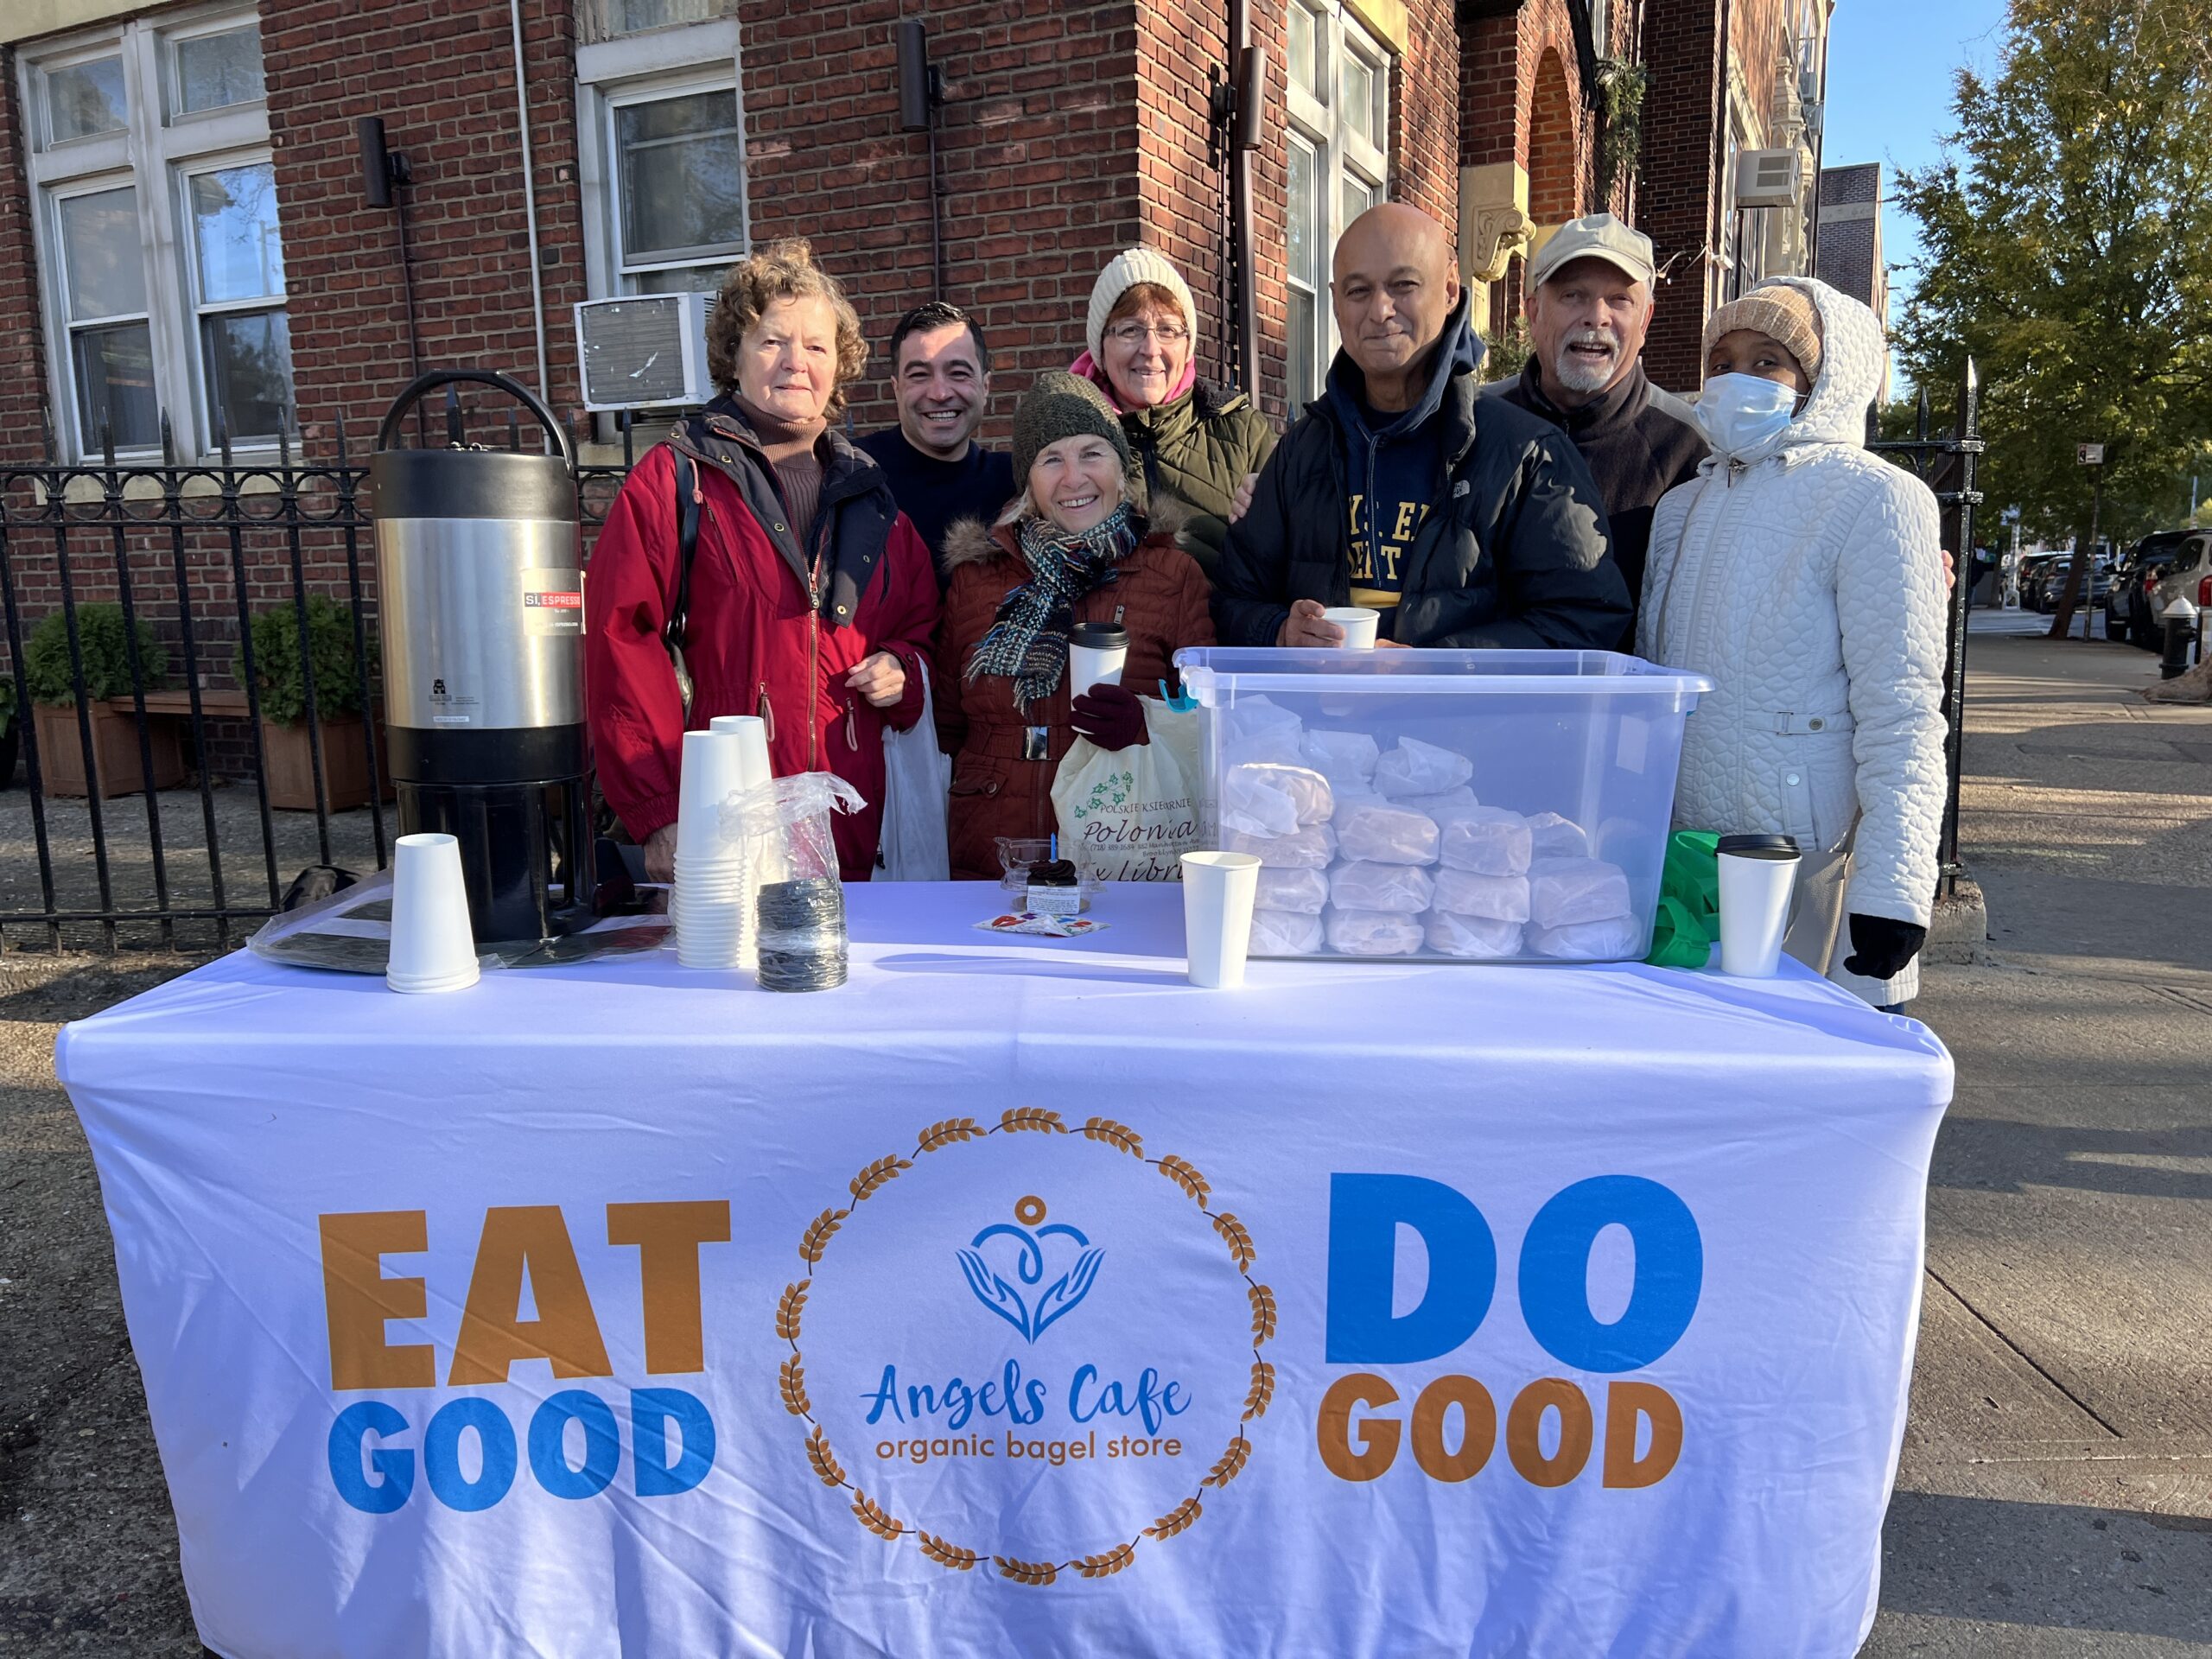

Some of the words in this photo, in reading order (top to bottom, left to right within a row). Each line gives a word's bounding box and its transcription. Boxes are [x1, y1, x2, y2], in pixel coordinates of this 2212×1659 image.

[1084, 819, 1198, 843] Polonia
[1090, 842, 1106, 852] (718)
[1100, 803, 1139, 814] POLSKIE
[320, 1201, 731, 1389] EAT
[1325, 1173, 1704, 1373] DO
[861, 1358, 1046, 1430] Angels
[1068, 1363, 1192, 1437] Cafe
[1317, 1373, 1684, 1489] GOOD
[328, 1388, 716, 1514] GOOD
[876, 1431, 995, 1465] organic
[1006, 1431, 1096, 1466] bagel
[1106, 1433, 1183, 1458] store
